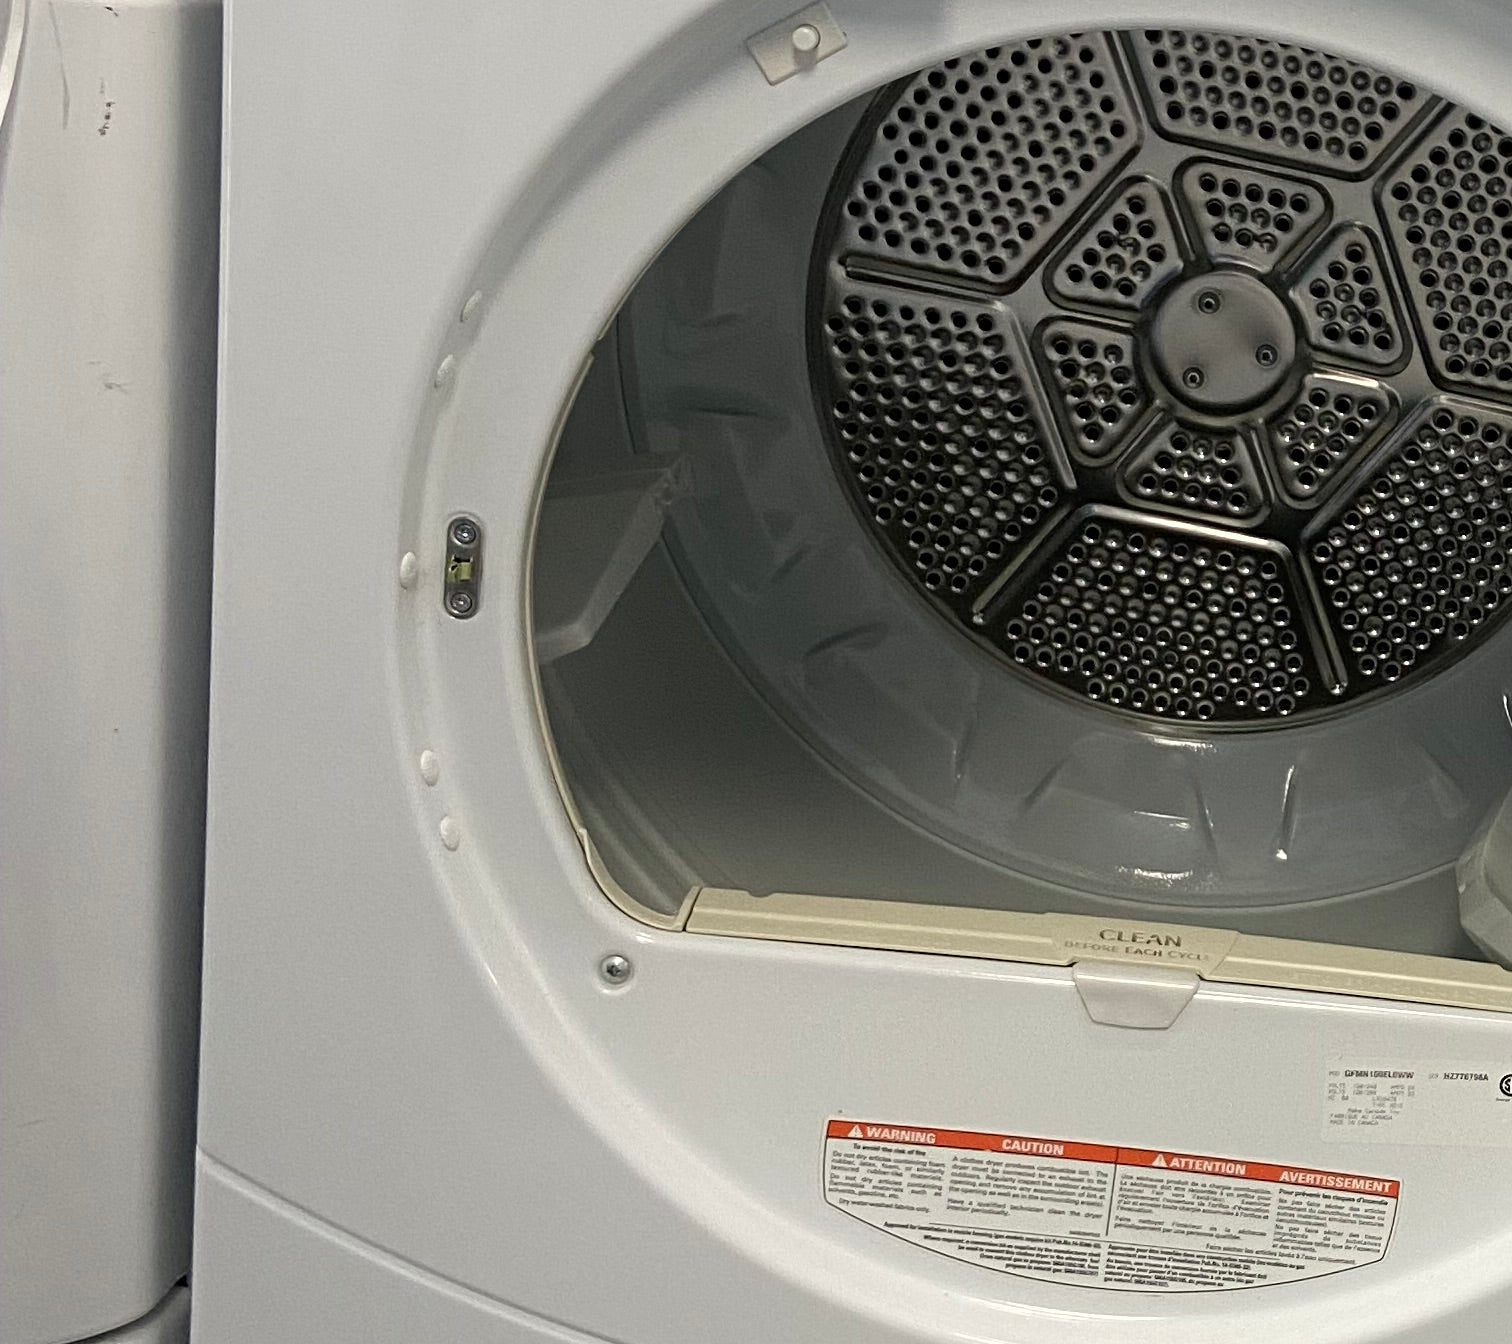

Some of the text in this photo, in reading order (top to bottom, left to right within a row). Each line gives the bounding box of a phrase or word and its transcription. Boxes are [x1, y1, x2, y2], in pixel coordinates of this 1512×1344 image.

[1100, 928, 1182, 948] CLEAN
[1125, 946, 1162, 957] EACH
[866, 1125, 937, 1144] WARNING
[1002, 1138, 1065, 1156] CAUTION
[1169, 1156, 1247, 1176] ATTENTION
[1279, 1170, 1392, 1193] AVERTISSEMENT
